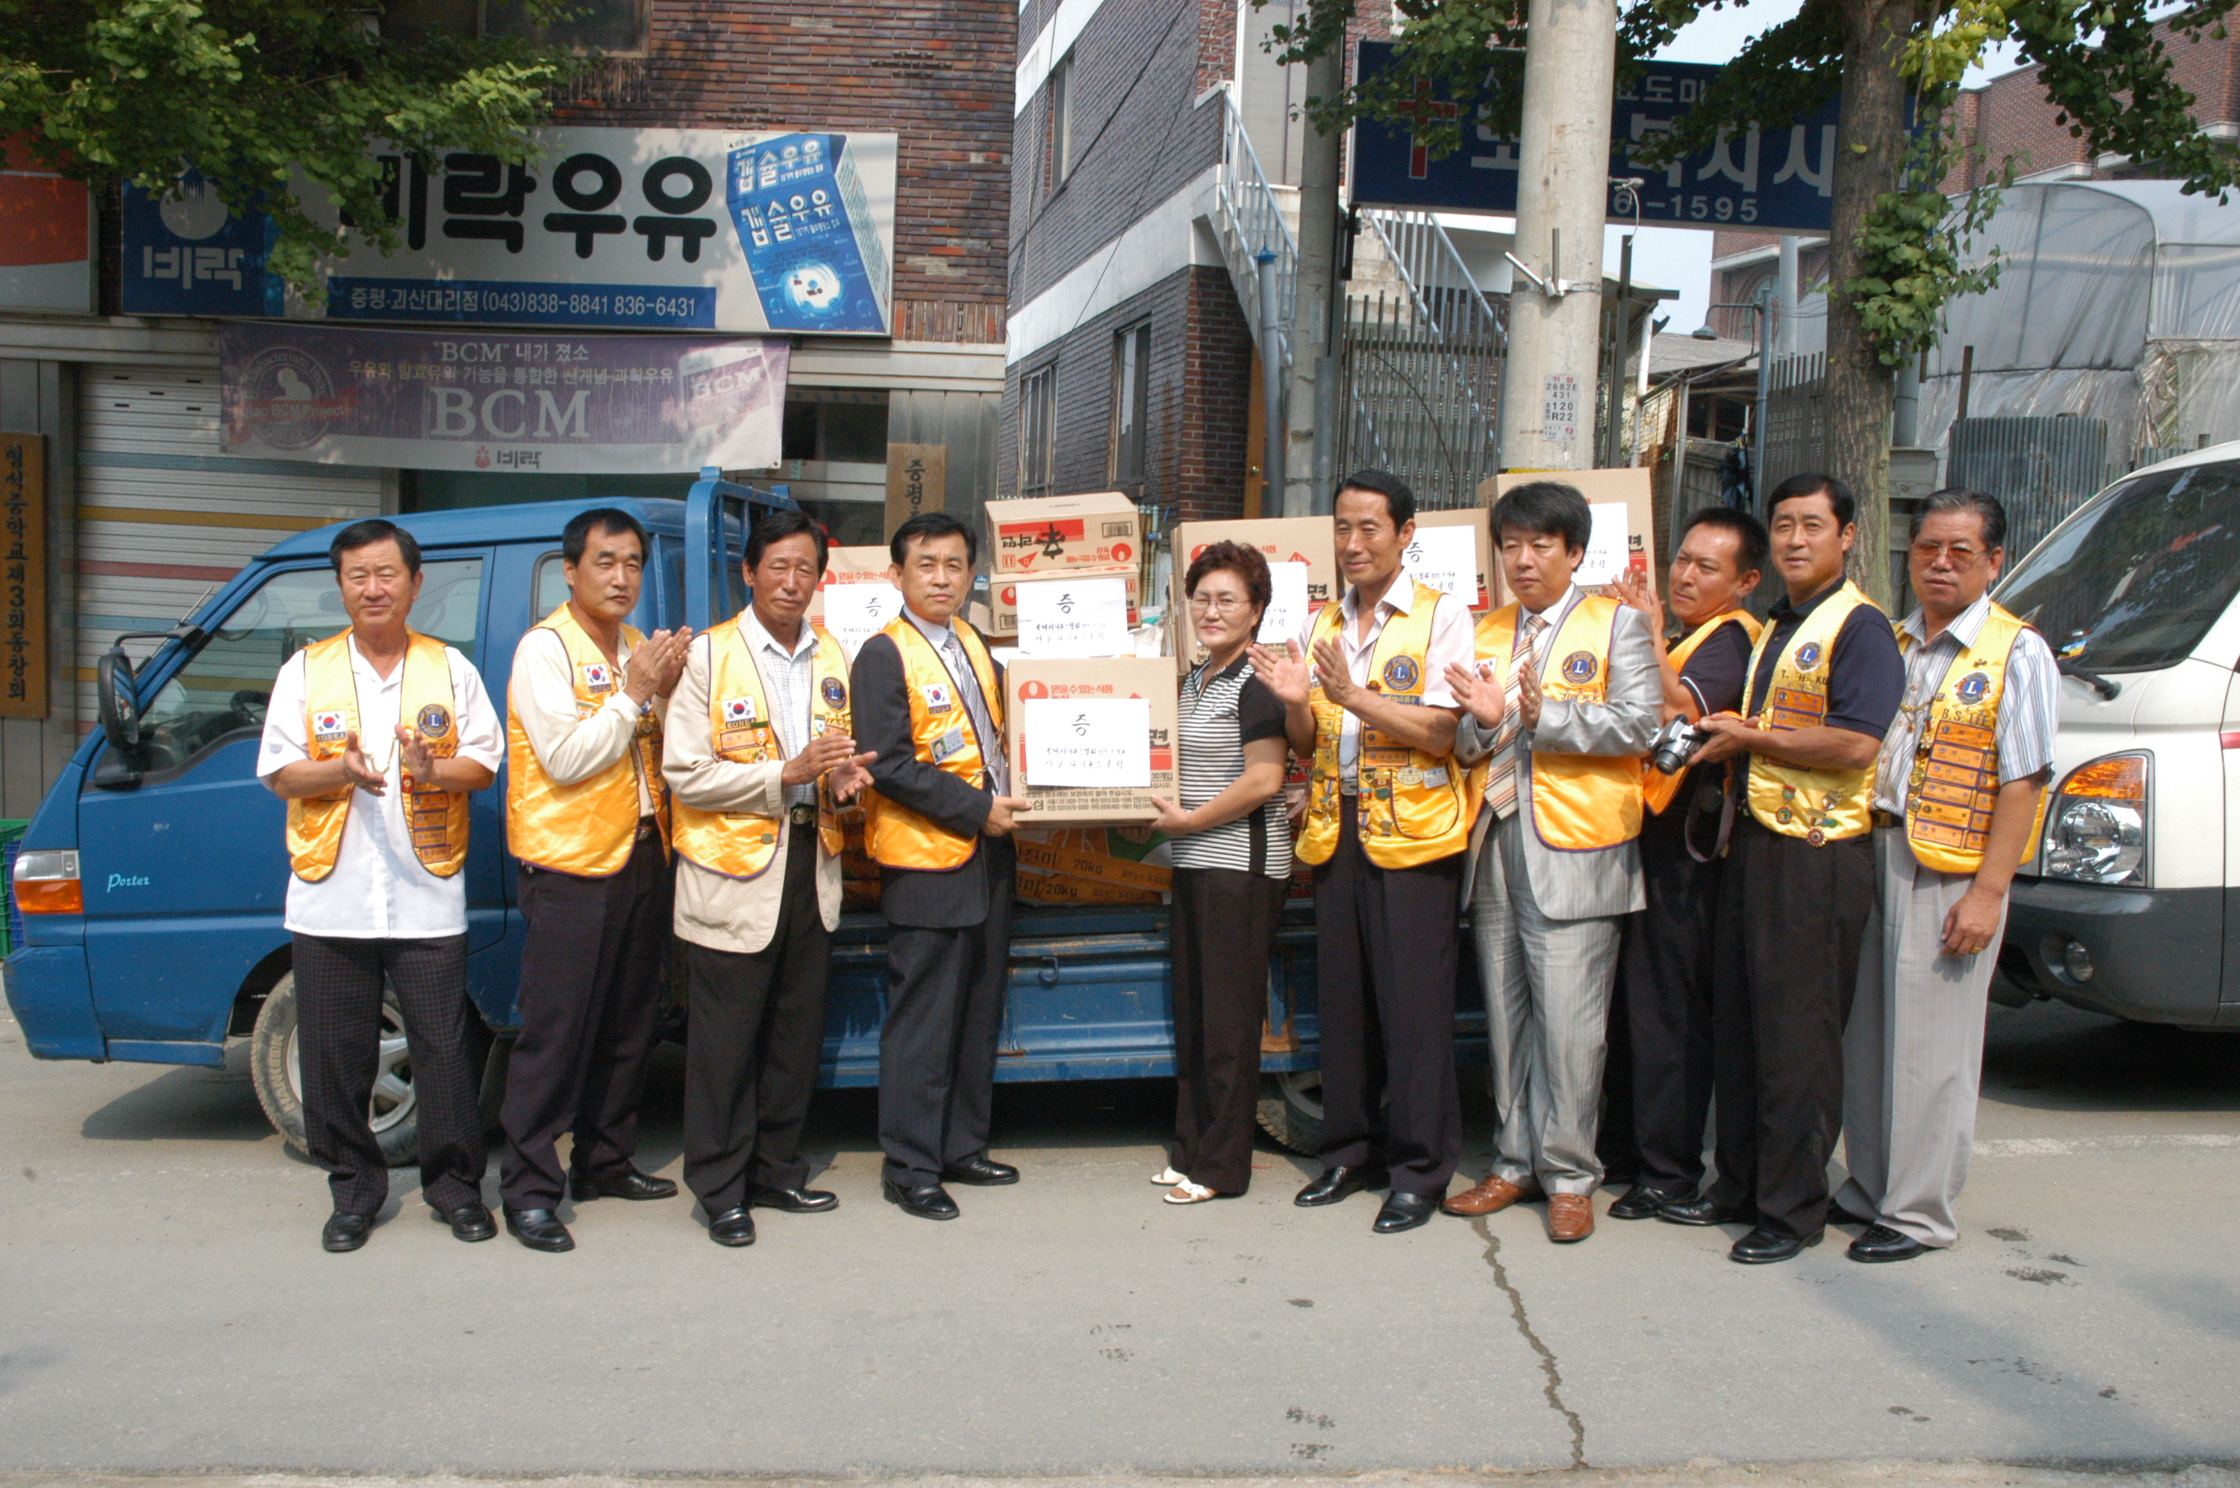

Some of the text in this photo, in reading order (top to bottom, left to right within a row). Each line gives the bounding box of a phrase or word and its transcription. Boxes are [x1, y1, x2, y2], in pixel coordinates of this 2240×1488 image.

[143, 246, 245, 291] 비락
[482, 289, 608, 315] (043)838-8841
[615, 293, 696, 318] 836-6431
[516, 342, 550, 363] 내가
[349, 361, 392, 379] 우유와
[463, 365, 507, 385] 기능을
[514, 366, 558, 385] 통합한
[563, 366, 608, 386] 신개념
[690, 366, 763, 399] BCM
[271, 404, 301, 417] BCM
[303, 404, 345, 419] Project
[430, 386, 591, 439] BCM
[1552, 402, 1574, 411] 120
[496, 448, 542, 470] 비락
[865, 597, 882, 618] 증
[1056, 593, 1075, 614] 증
[1396, 666, 1406, 679] L
[1574, 660, 1584, 674] L
[1050, 684, 1114, 694] 믿을 수 있는 식품
[1965, 680, 1977, 695] L
[430, 714, 440, 727] L
[1071, 713, 1091, 736] 증
[1073, 858, 1103, 874] 20kg
[107, 873, 151, 893] Porter
[1045, 883, 1078, 898] 20kg
